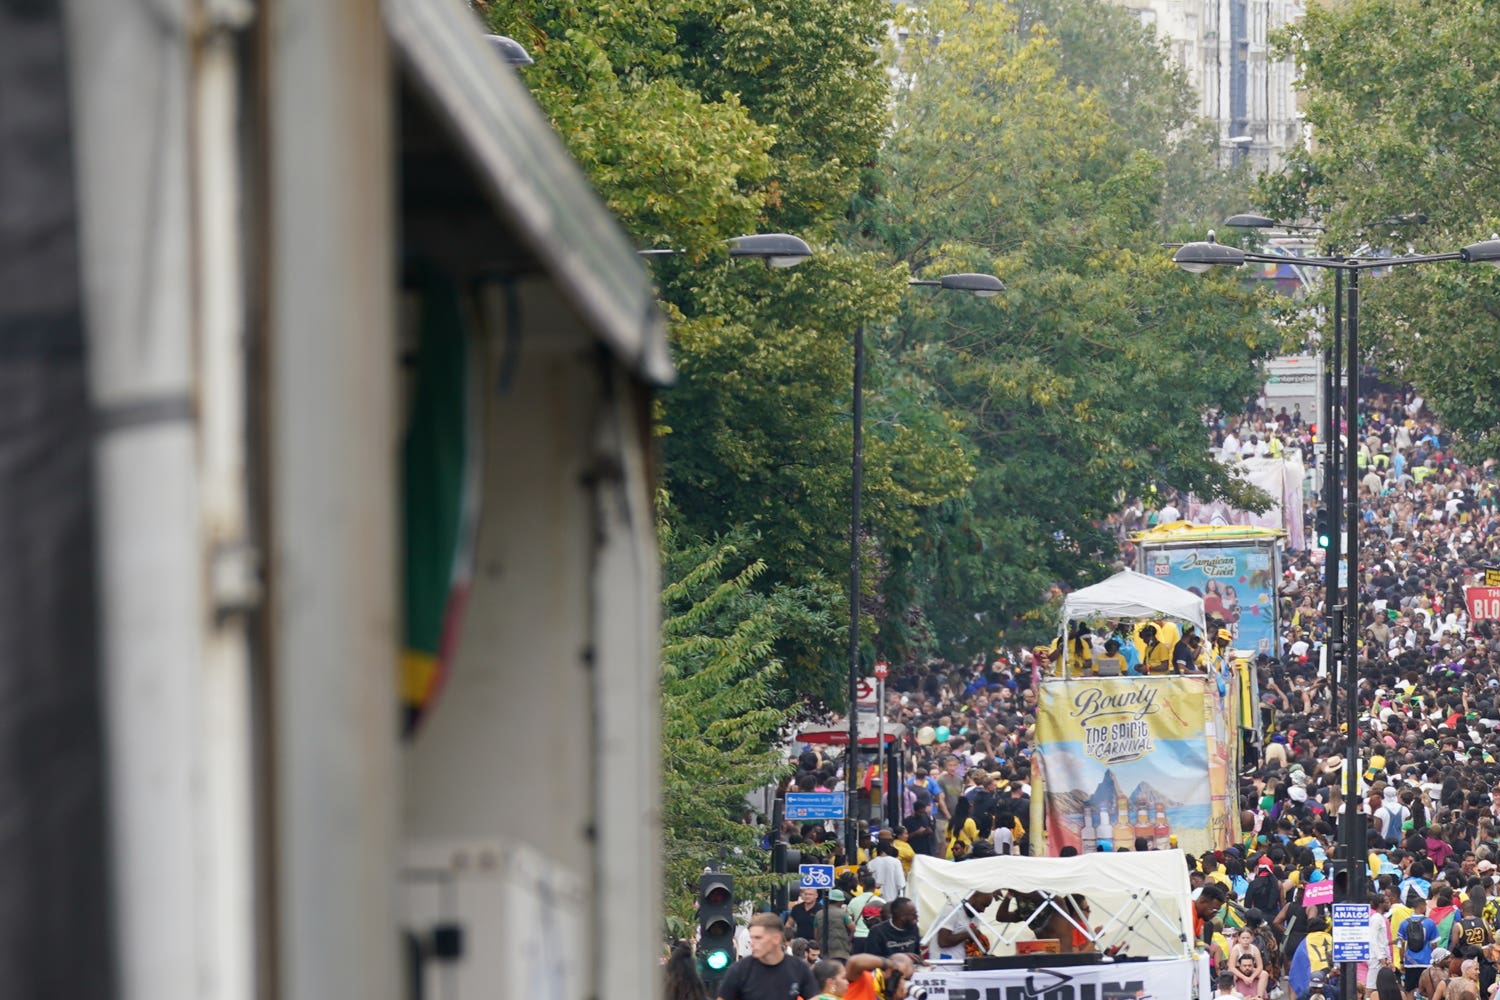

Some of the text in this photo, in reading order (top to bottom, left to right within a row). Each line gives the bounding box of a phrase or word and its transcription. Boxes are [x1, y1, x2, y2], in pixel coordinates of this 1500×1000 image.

[1070, 684, 1160, 723] Bounty
[1086, 726, 1108, 744] The
[1095, 739, 1152, 758] CARNIVAL
[1465, 927, 1485, 944] 23
